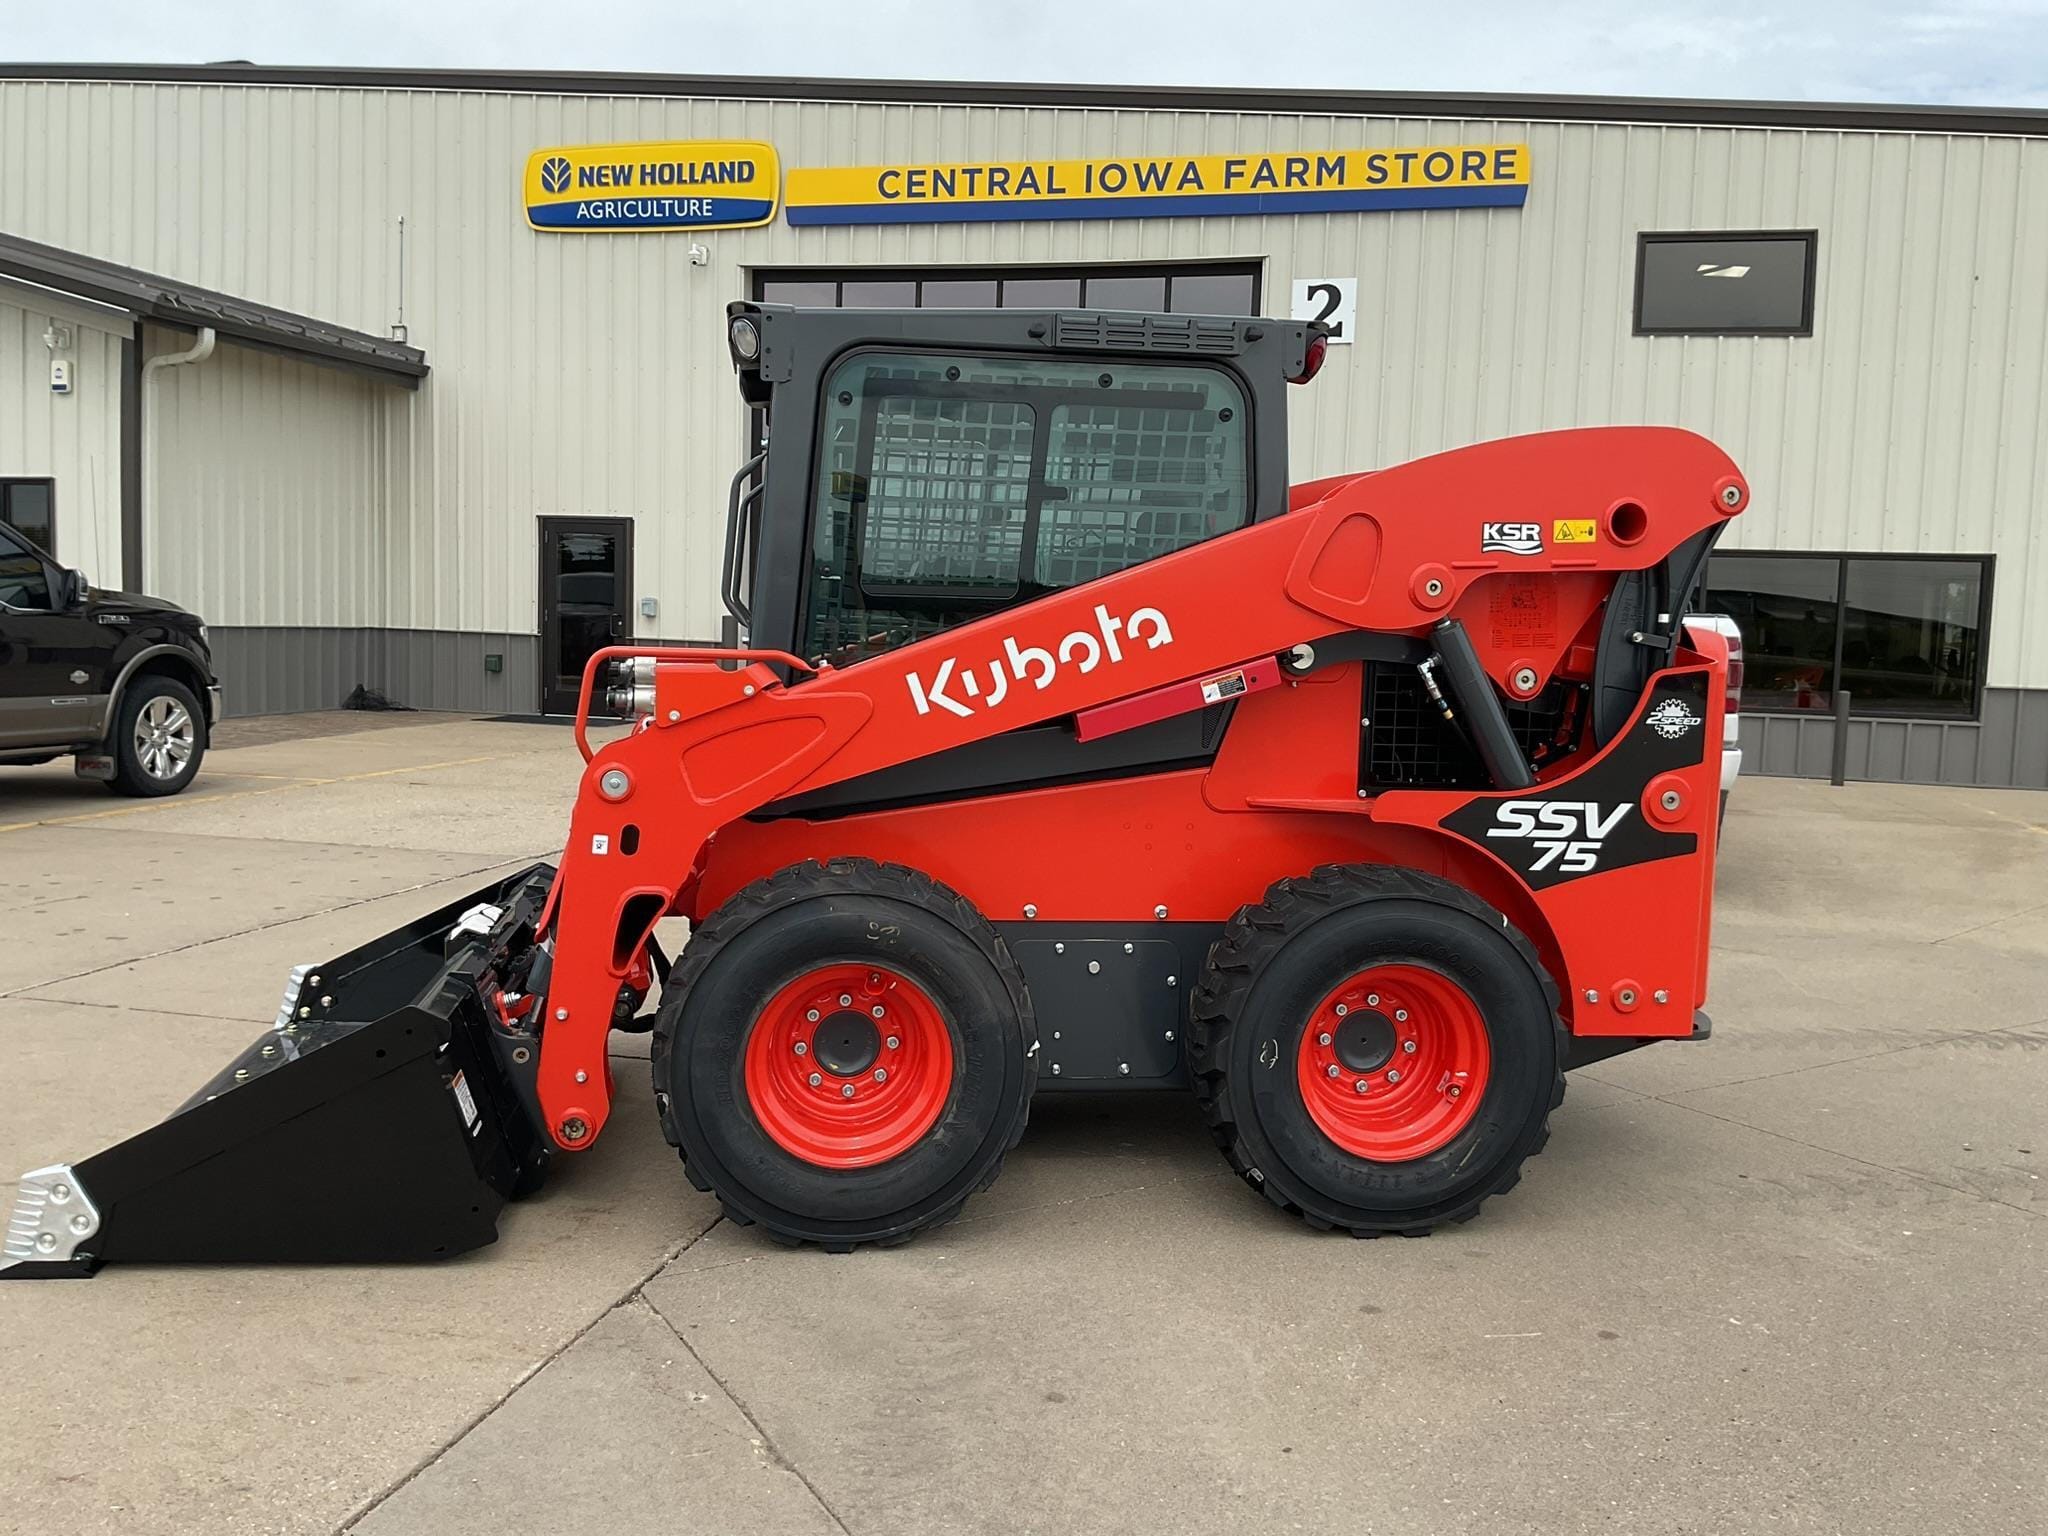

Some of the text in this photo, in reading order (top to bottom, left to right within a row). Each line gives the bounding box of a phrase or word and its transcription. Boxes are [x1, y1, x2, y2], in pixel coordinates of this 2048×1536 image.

[578, 160, 755, 187] NEW HOLLAND
[878, 149, 1517, 199] CENTRAL IOWA FARM STORE
[577, 199, 713, 219] AGRICULTURE
[1307, 283, 1343, 337] 2
[1482, 522, 1541, 541] KSR
[905, 604, 1174, 717] Kubota
[1486, 800, 1634, 839] SSV
[1528, 840, 1602, 872] 75
